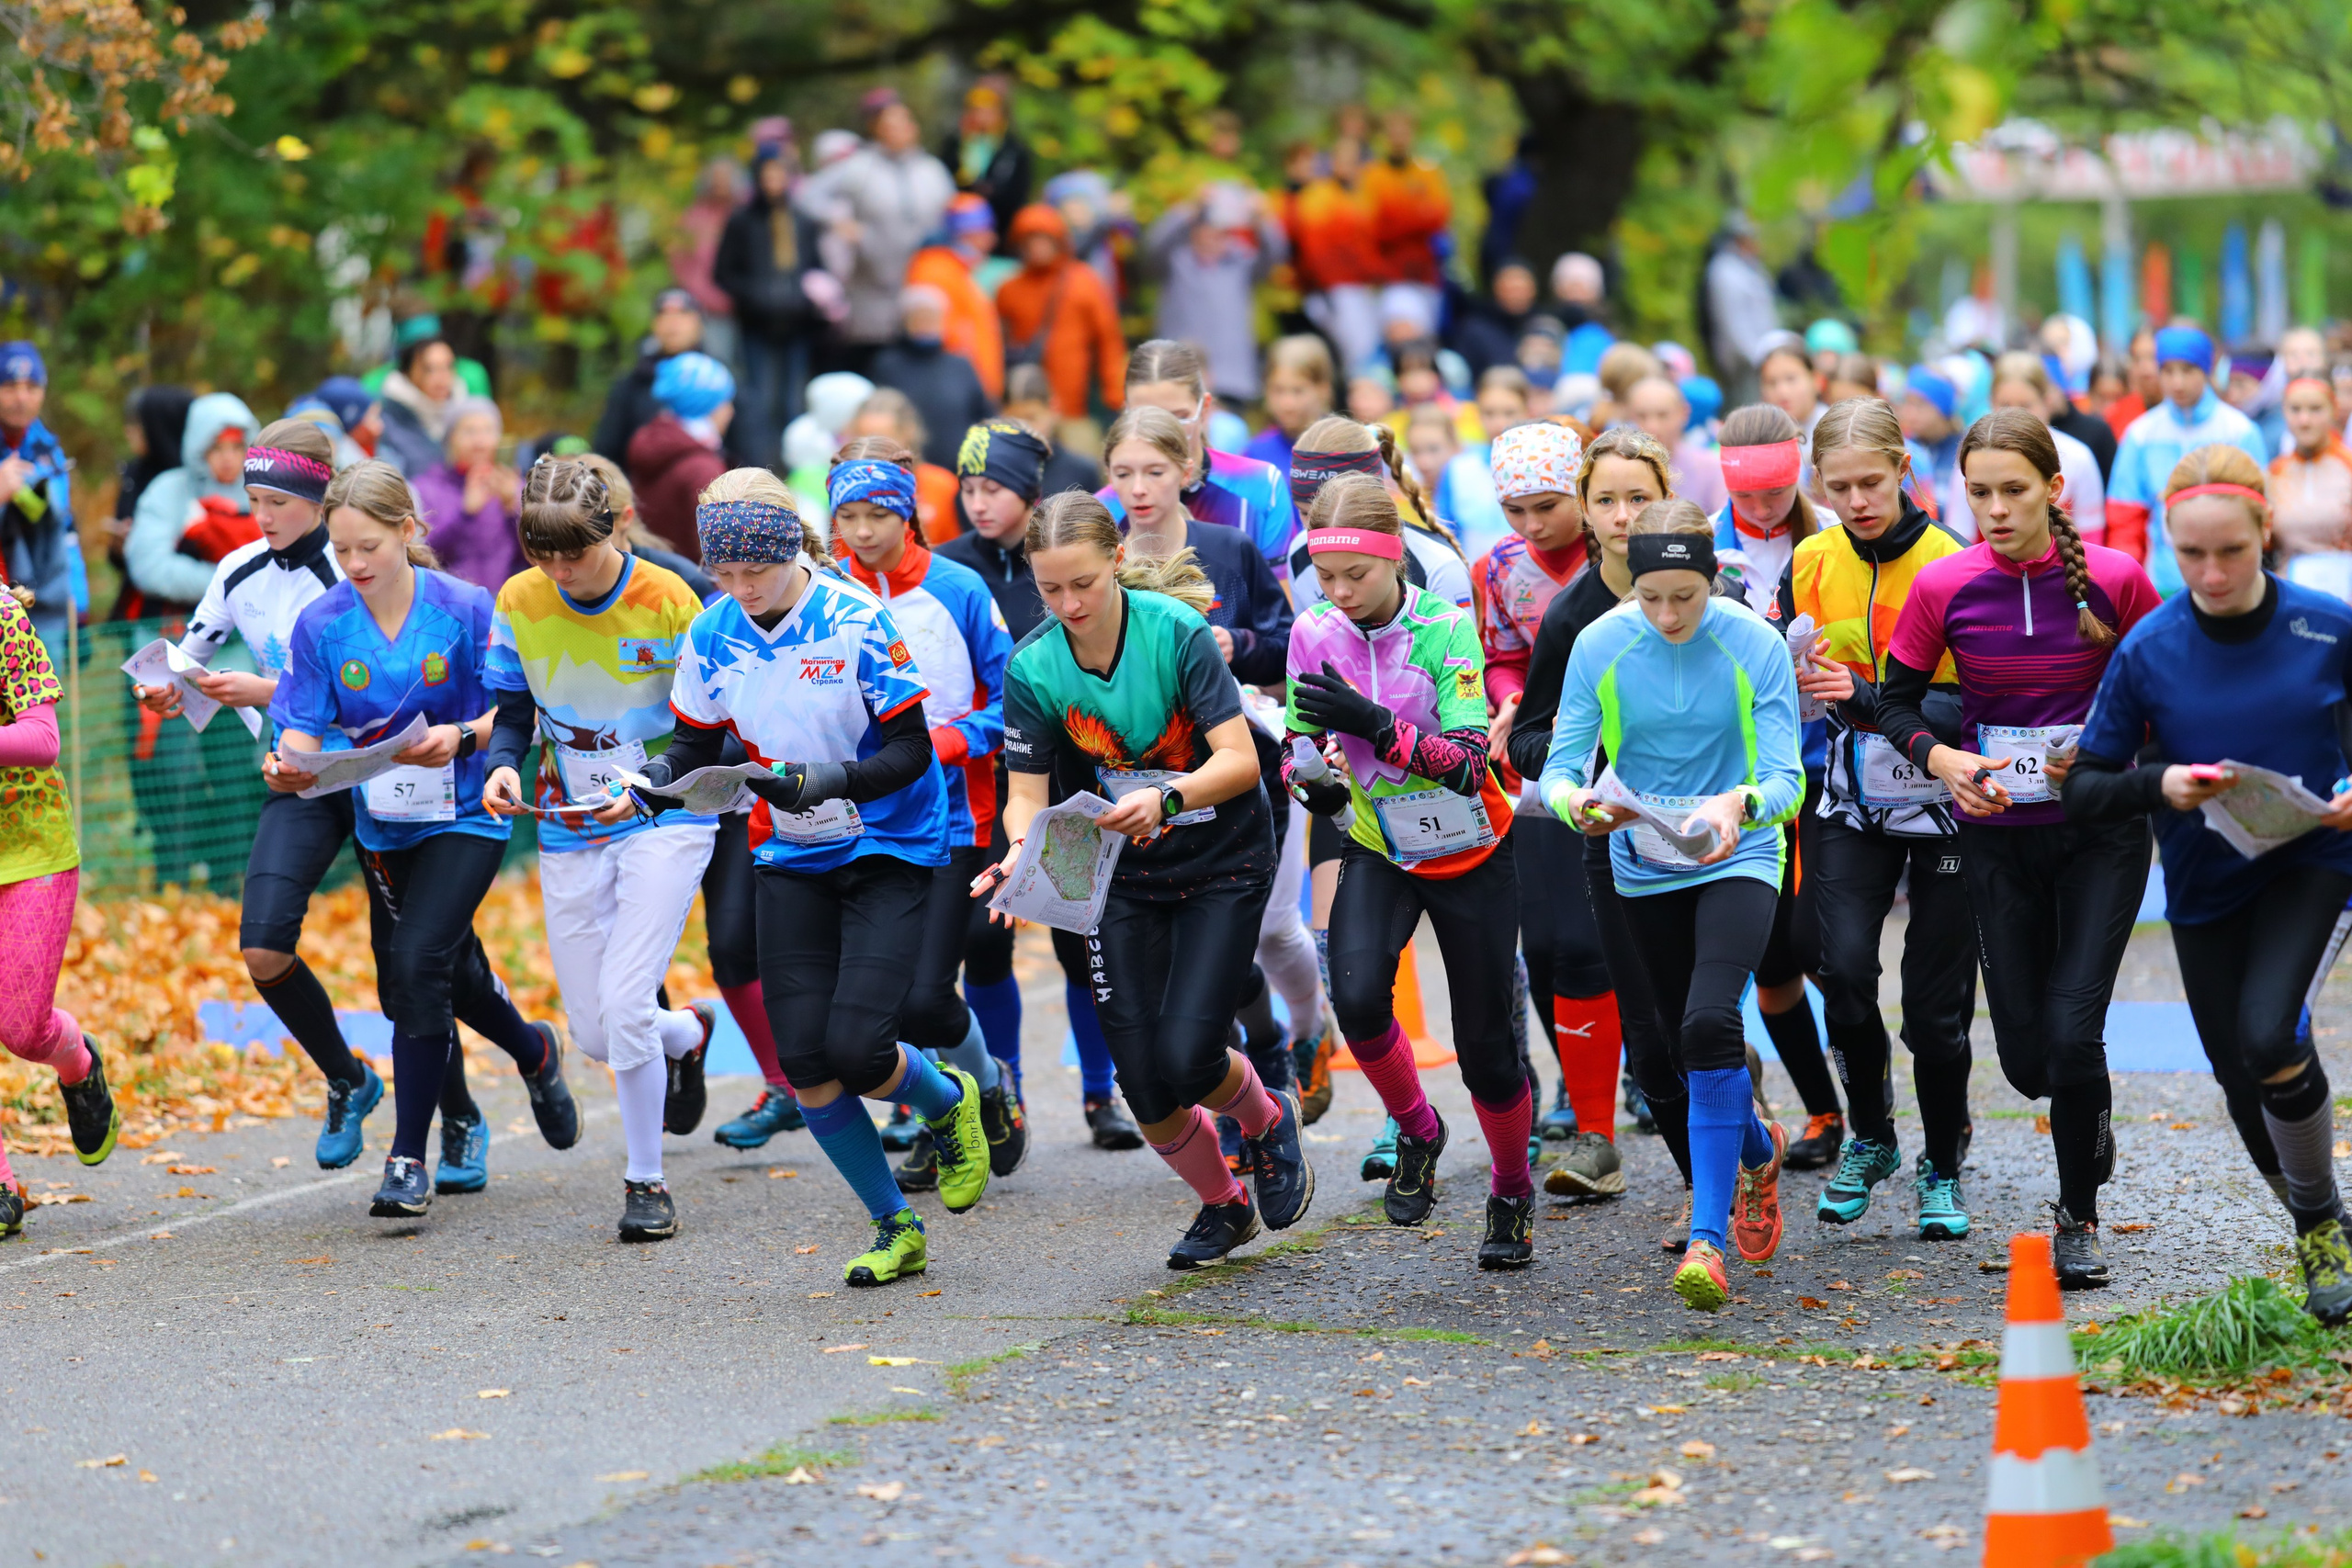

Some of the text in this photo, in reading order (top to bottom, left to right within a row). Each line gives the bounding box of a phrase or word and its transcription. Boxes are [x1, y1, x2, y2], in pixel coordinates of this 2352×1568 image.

[1309, 536, 1360, 547] noname
[811, 678, 843, 686] Стрелка
[1892, 763, 1915, 780] 63
[2015, 757, 2038, 774] 62
[590, 773, 612, 787] 56
[393, 783, 415, 797] 57
[814, 816, 839, 827] линия
[1419, 816, 1442, 833] 51
[1442, 829, 1466, 840] линия
